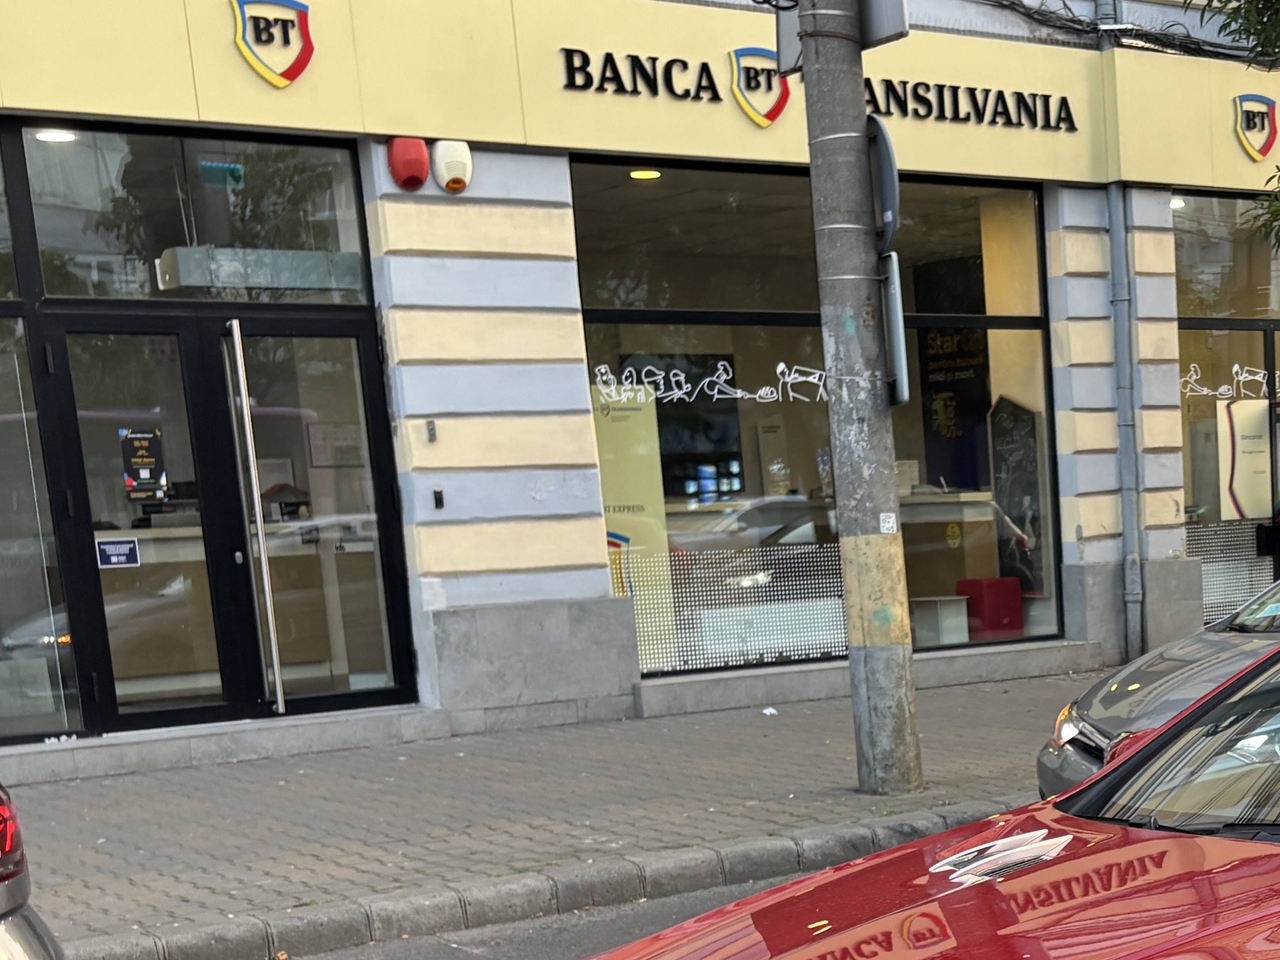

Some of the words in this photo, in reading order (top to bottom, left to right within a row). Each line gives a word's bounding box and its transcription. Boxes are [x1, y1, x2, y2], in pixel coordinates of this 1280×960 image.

[248, 15, 296, 47] BT
[559, 47, 723, 103] BANCA
[742, 66, 778, 92] BT
[799, 68, 1079, 133] ANSILVANIA
[1243, 109, 1269, 132] BT
